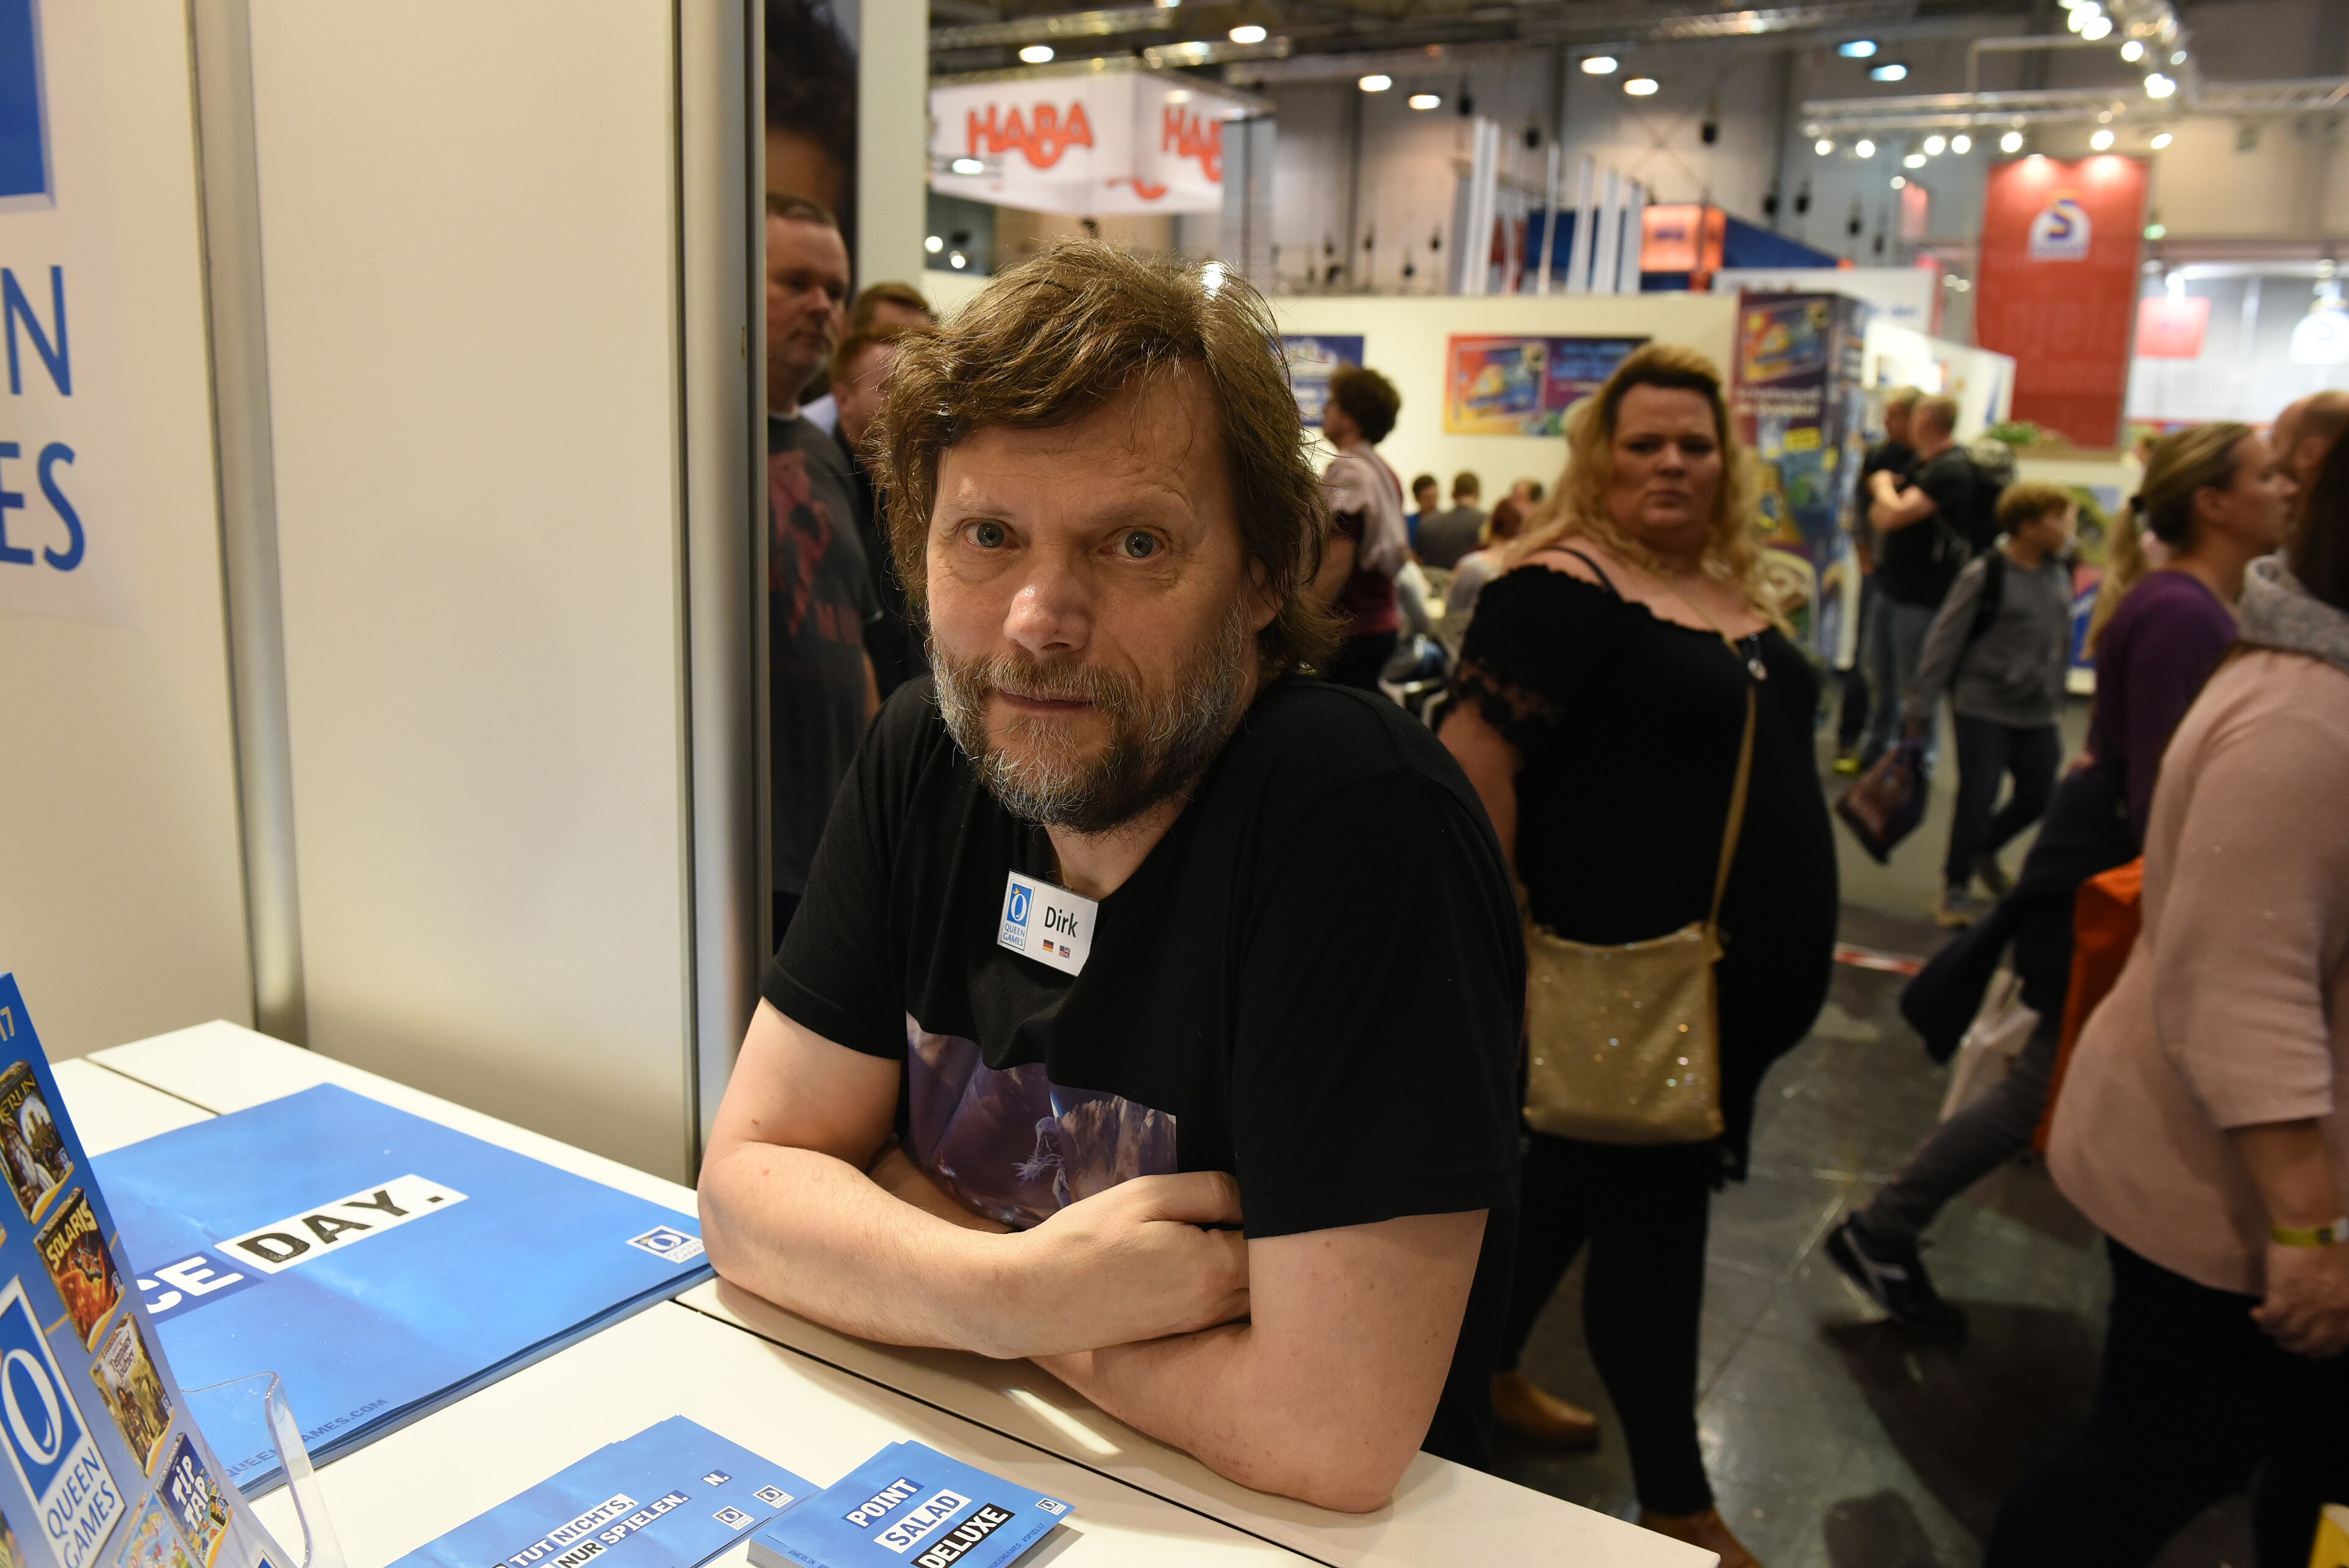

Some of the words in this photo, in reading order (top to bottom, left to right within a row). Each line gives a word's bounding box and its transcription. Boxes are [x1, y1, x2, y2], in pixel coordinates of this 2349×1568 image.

[967, 102, 1094, 169] HABA
[1162, 103, 1223, 182] HAB
[0, 265, 72, 396] N
[0, 442, 86, 571] ES
[1003, 933, 1024, 946] GAMES
[1004, 923, 1025, 937] QUEEN
[1044, 906, 1078, 938] Dirk
[0, 1074, 37, 1123] ERLIN
[45, 1198, 98, 1273] SOLARIS
[237, 1190, 444, 1263] DAY.
[48, 1446, 100, 1540] QUEEN
[64, 1480, 116, 1568] GAMES
[184, 1476, 209, 1532] TAP
[846, 1479, 918, 1527] POINT
[885, 1496, 960, 1546] SALAD
[508, 1539, 554, 1567] TUT
[552, 1498, 636, 1543] NICHTS,
[557, 1542, 604, 1568] NUR
[600, 1494, 689, 1545] SPIELEN.
[788, 1550, 816, 1565] #MERLIN
[918, 1507, 1009, 1568] DELUXE
[1022, 1522, 1045, 1542] #SPIEL17
